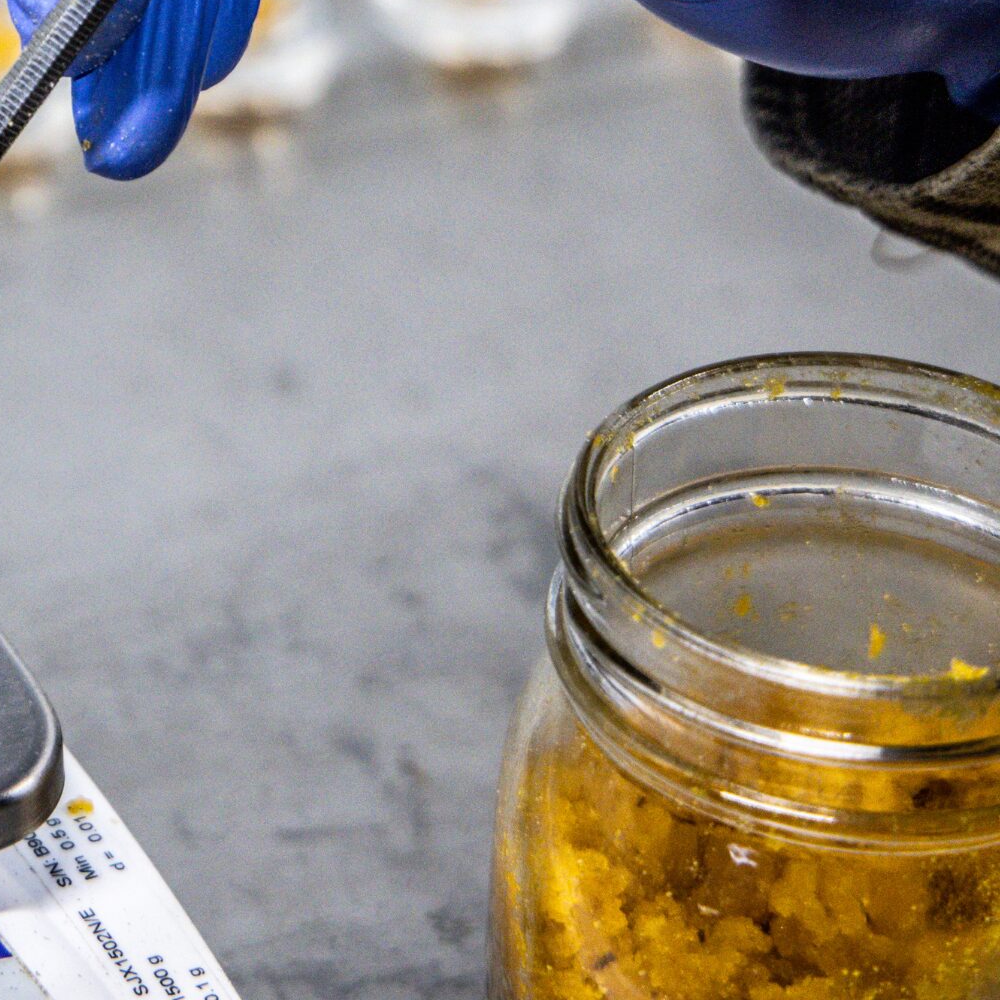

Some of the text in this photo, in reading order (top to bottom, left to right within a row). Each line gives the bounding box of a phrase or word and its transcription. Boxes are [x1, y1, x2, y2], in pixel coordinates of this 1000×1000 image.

[50, 829, 75, 850] 0.5
[73, 816, 102, 843] 0.01
[43, 858, 72, 888] S/N:
[74, 855, 98, 880] Min
[78, 907, 149, 996] SJX1502N/E
[147, 954, 164, 965] g
[188, 966, 205, 977] g
